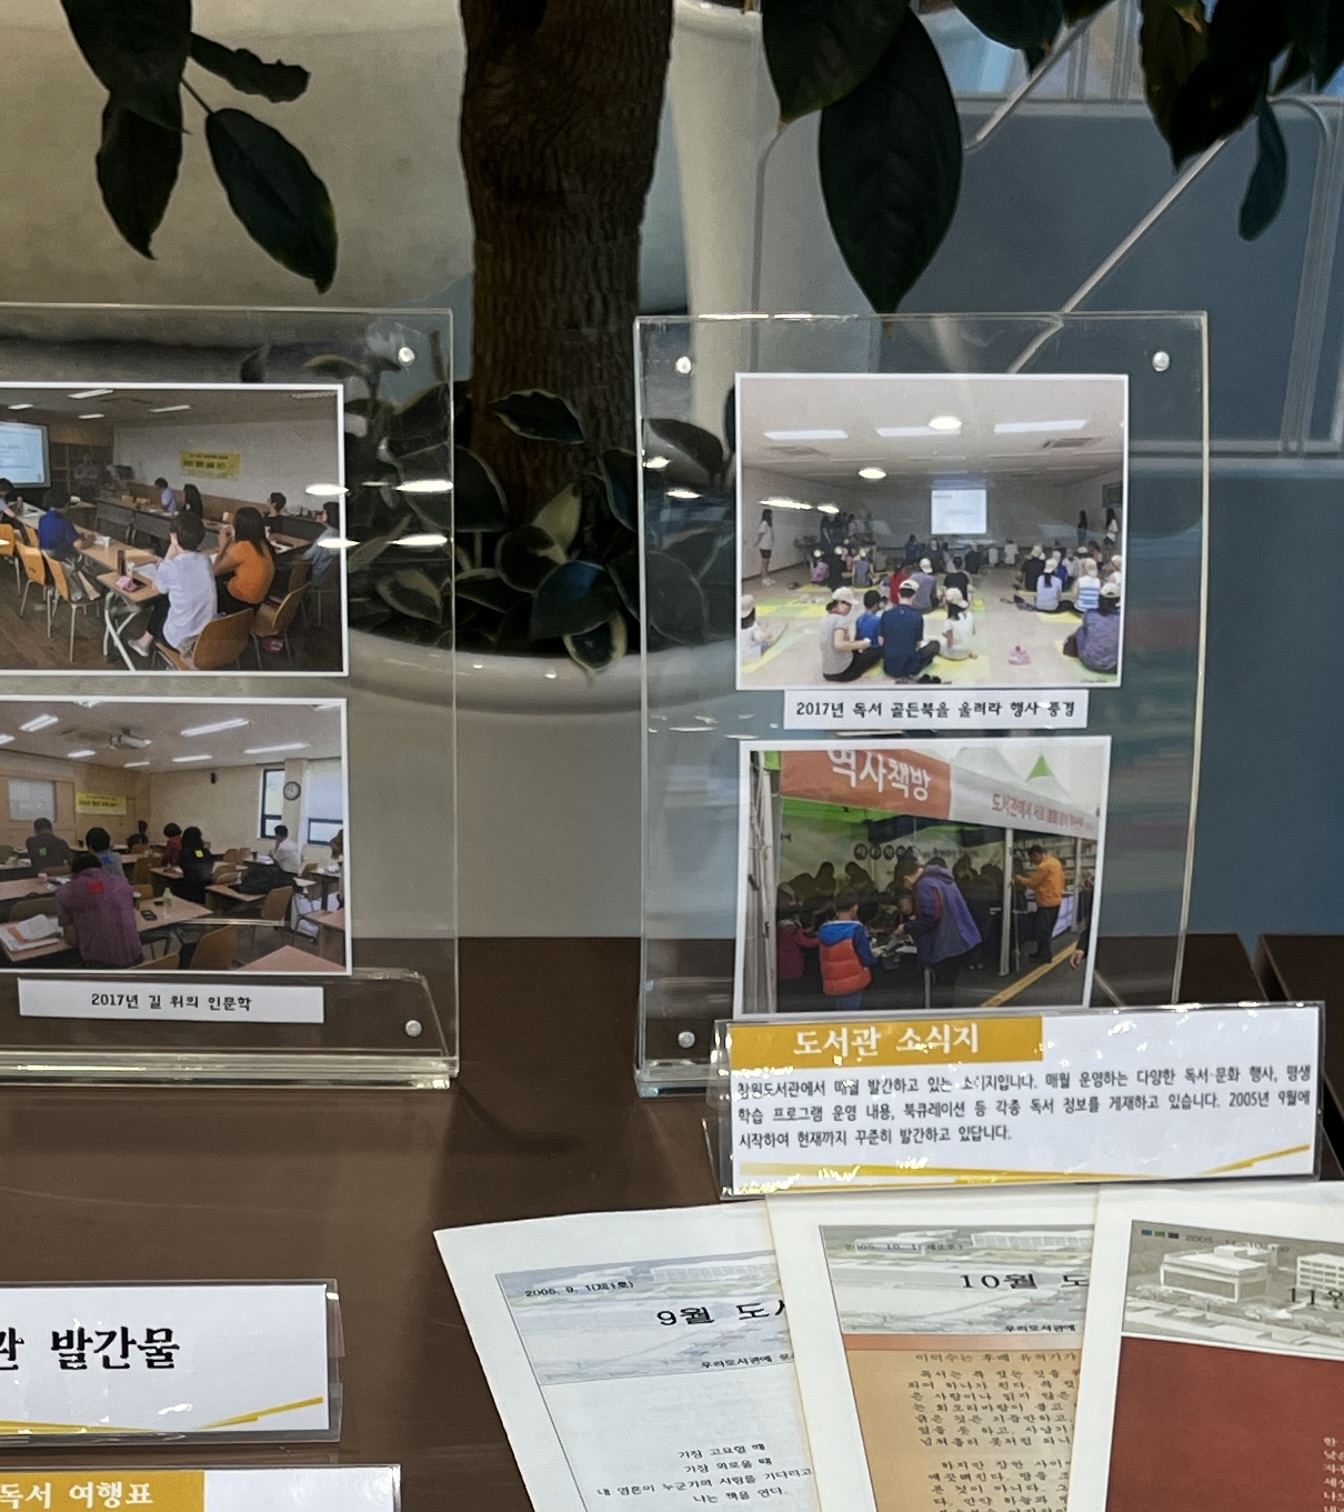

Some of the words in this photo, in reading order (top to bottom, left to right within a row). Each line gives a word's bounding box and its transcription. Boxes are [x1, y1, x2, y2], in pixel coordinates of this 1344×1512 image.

[797, 702, 843, 718] 2017년
[853, 702, 881, 718] 독서
[891, 702, 949, 718] 골든북을
[959, 702, 1002, 718] 울려라
[1011, 701, 1039, 717] 행사
[1047, 701, 1074, 717] 풍경
[92, 993, 138, 1009] 2017년
[149, 995, 161, 1009] 길
[170, 996, 198, 1008] 위의
[208, 996, 251, 1011] 인문학
[794, 1027, 880, 1057] 도서관
[896, 1024, 978, 1053] 소식지
[963, 1273, 1037, 1289] 10월
[656, 1304, 714, 1327] 9월
[51, 1326, 180, 1370] 발간물
[69, 1481, 153, 1508] 여행표
